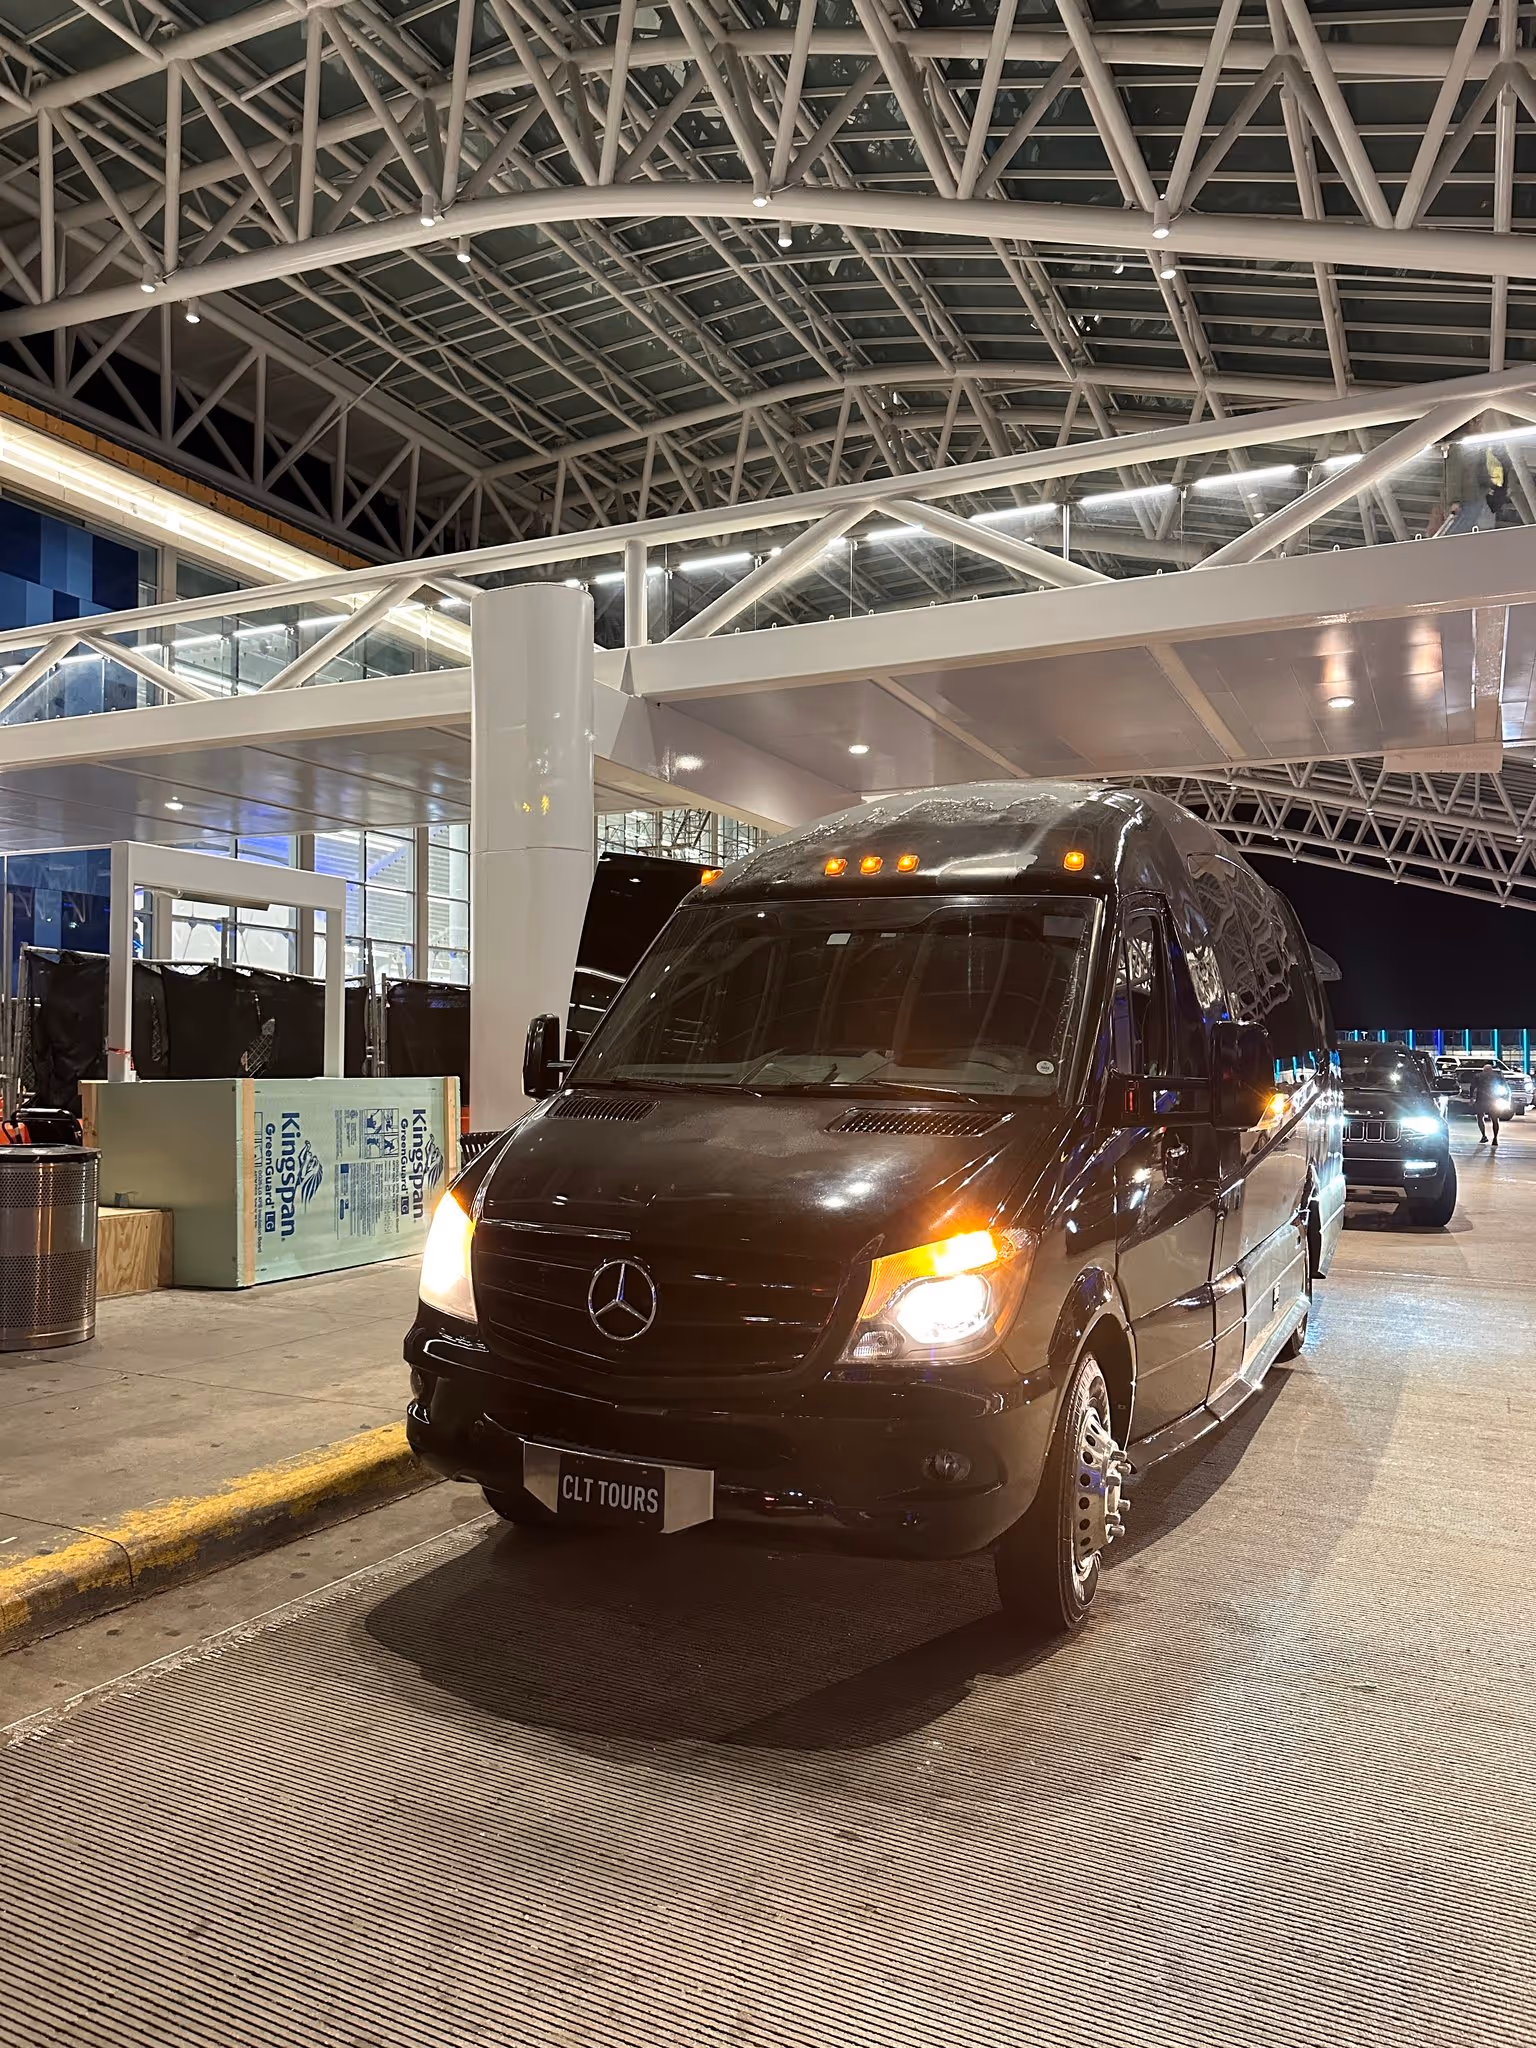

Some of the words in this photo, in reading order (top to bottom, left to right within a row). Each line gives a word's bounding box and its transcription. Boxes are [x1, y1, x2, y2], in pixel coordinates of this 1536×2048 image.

[265, 1122, 276, 1204] GreenGuard
[275, 1112, 301, 1237] Kingspan
[400, 1118, 409, 1192] GreenGuard
[408, 1109, 427, 1219] Kingspan
[265, 1211, 276, 1233] LG
[401, 1196, 409, 1215] LG
[562, 1474, 594, 1503] CLT
[598, 1480, 659, 1514] TOURS
